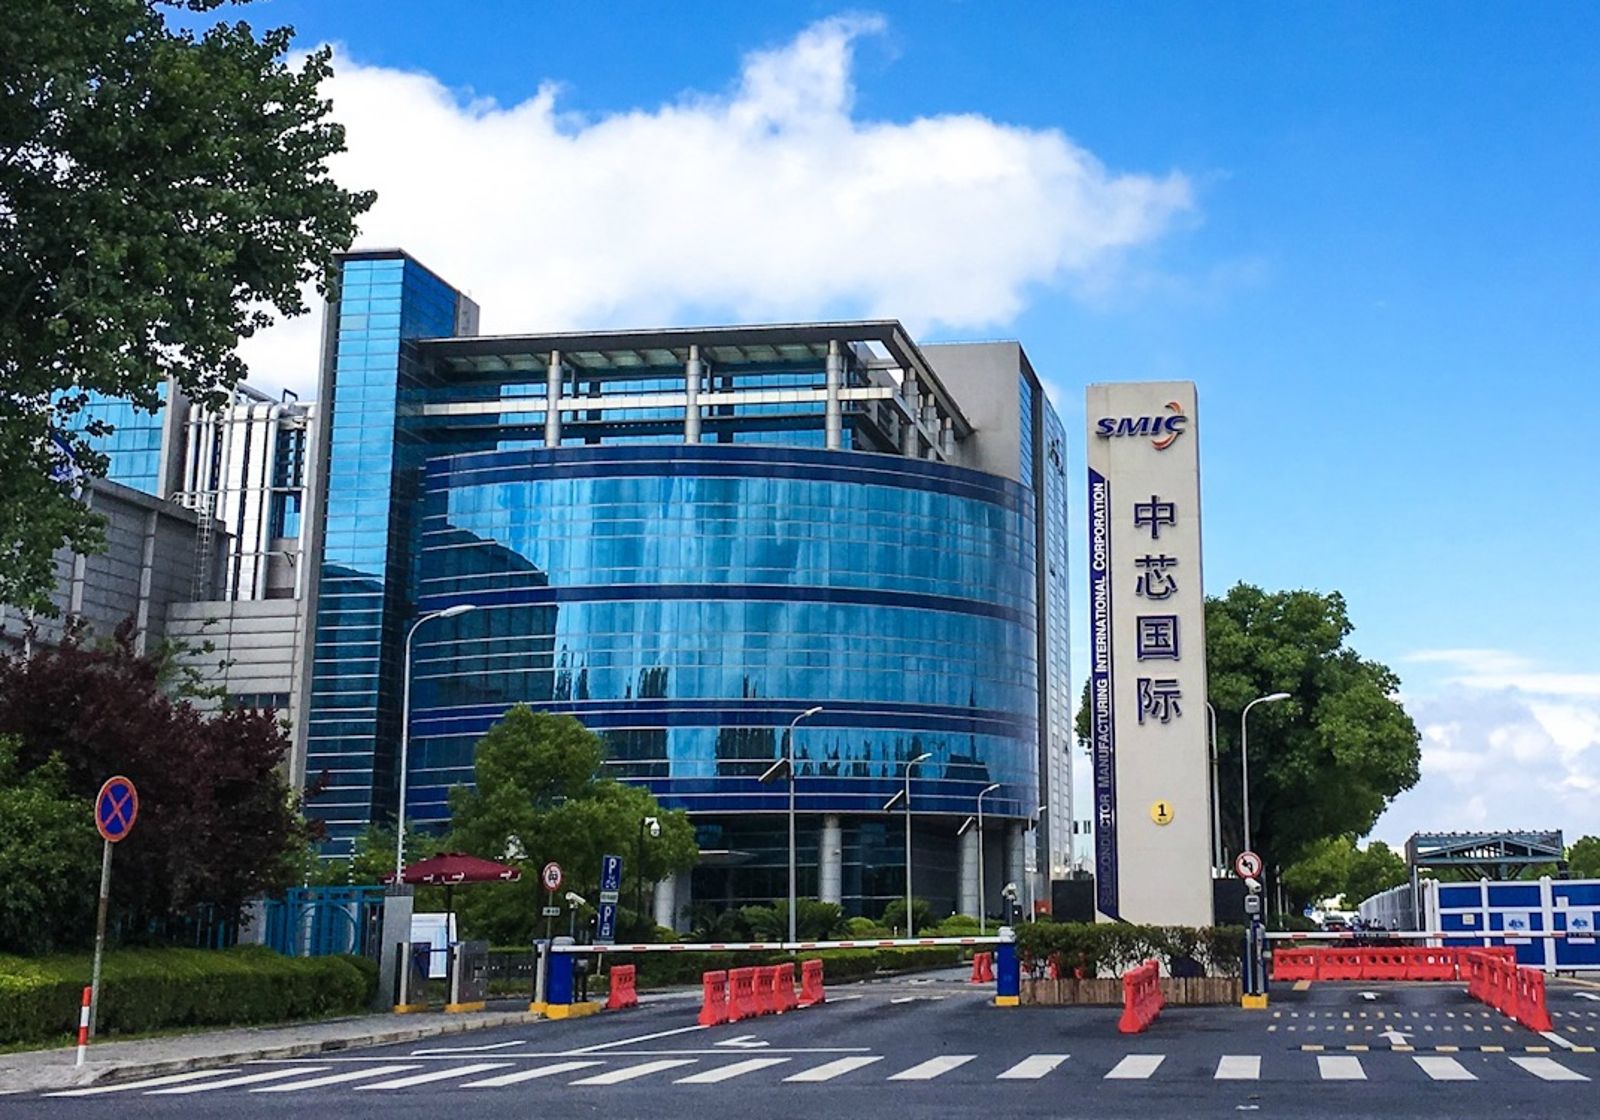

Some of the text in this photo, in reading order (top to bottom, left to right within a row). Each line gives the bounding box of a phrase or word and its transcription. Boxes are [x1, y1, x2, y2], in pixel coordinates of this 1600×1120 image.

[1096, 415, 1187, 437] SMIC
[1093, 482, 1106, 571] CORPORATION
[1095, 576, 1108, 672] INTERNATIONAL
[1134, 495, 1182, 725] 中芯国际
[1096, 679, 1110, 788] MANUFACTURING
[1157, 803, 1167, 817] 1
[608, 858, 617, 874] P
[604, 906, 612, 922] P
